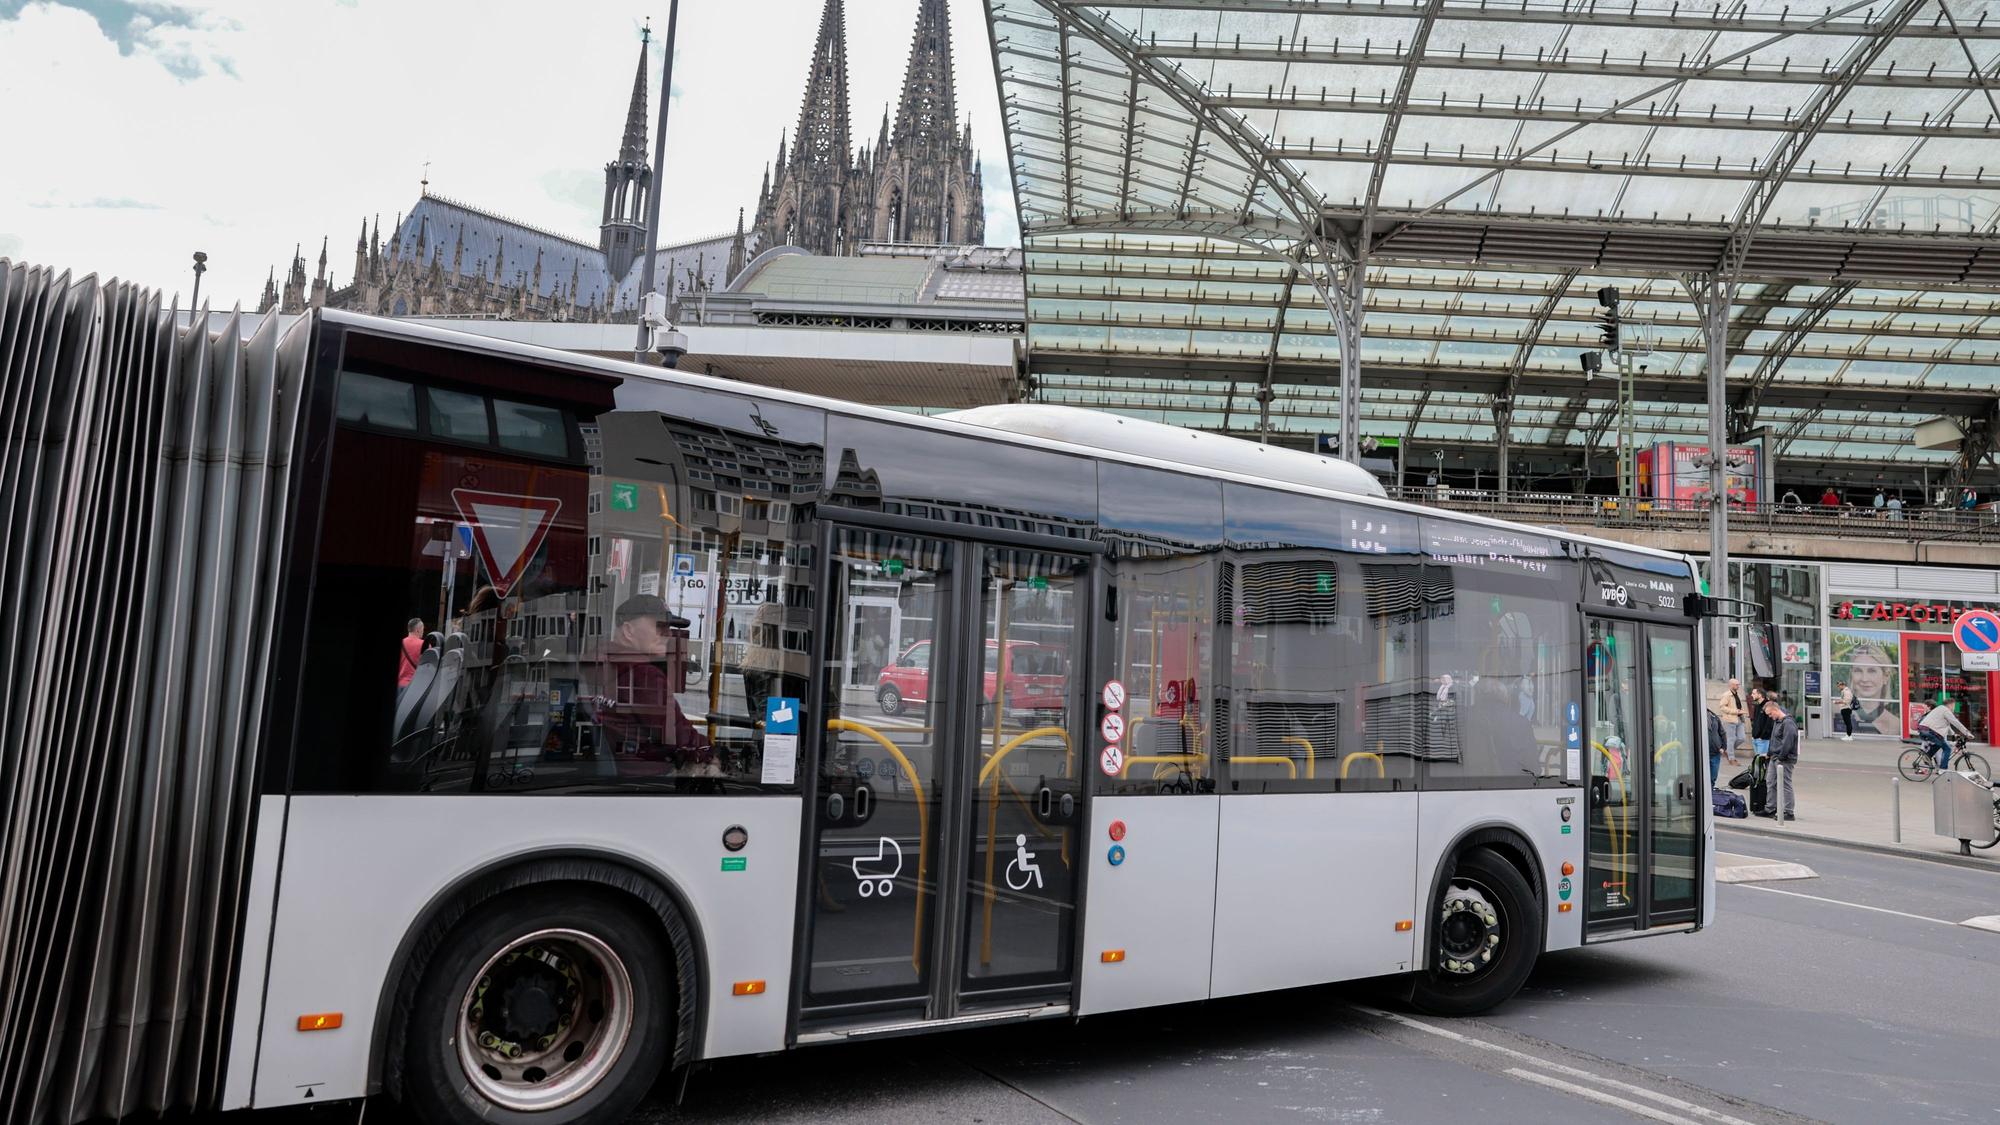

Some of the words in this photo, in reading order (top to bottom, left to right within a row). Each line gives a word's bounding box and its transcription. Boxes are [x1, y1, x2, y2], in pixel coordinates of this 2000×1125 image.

[1649, 579, 1674, 593] MAN
[1601, 587, 1617, 600] KVB
[1658, 595, 1675, 608] 5022
